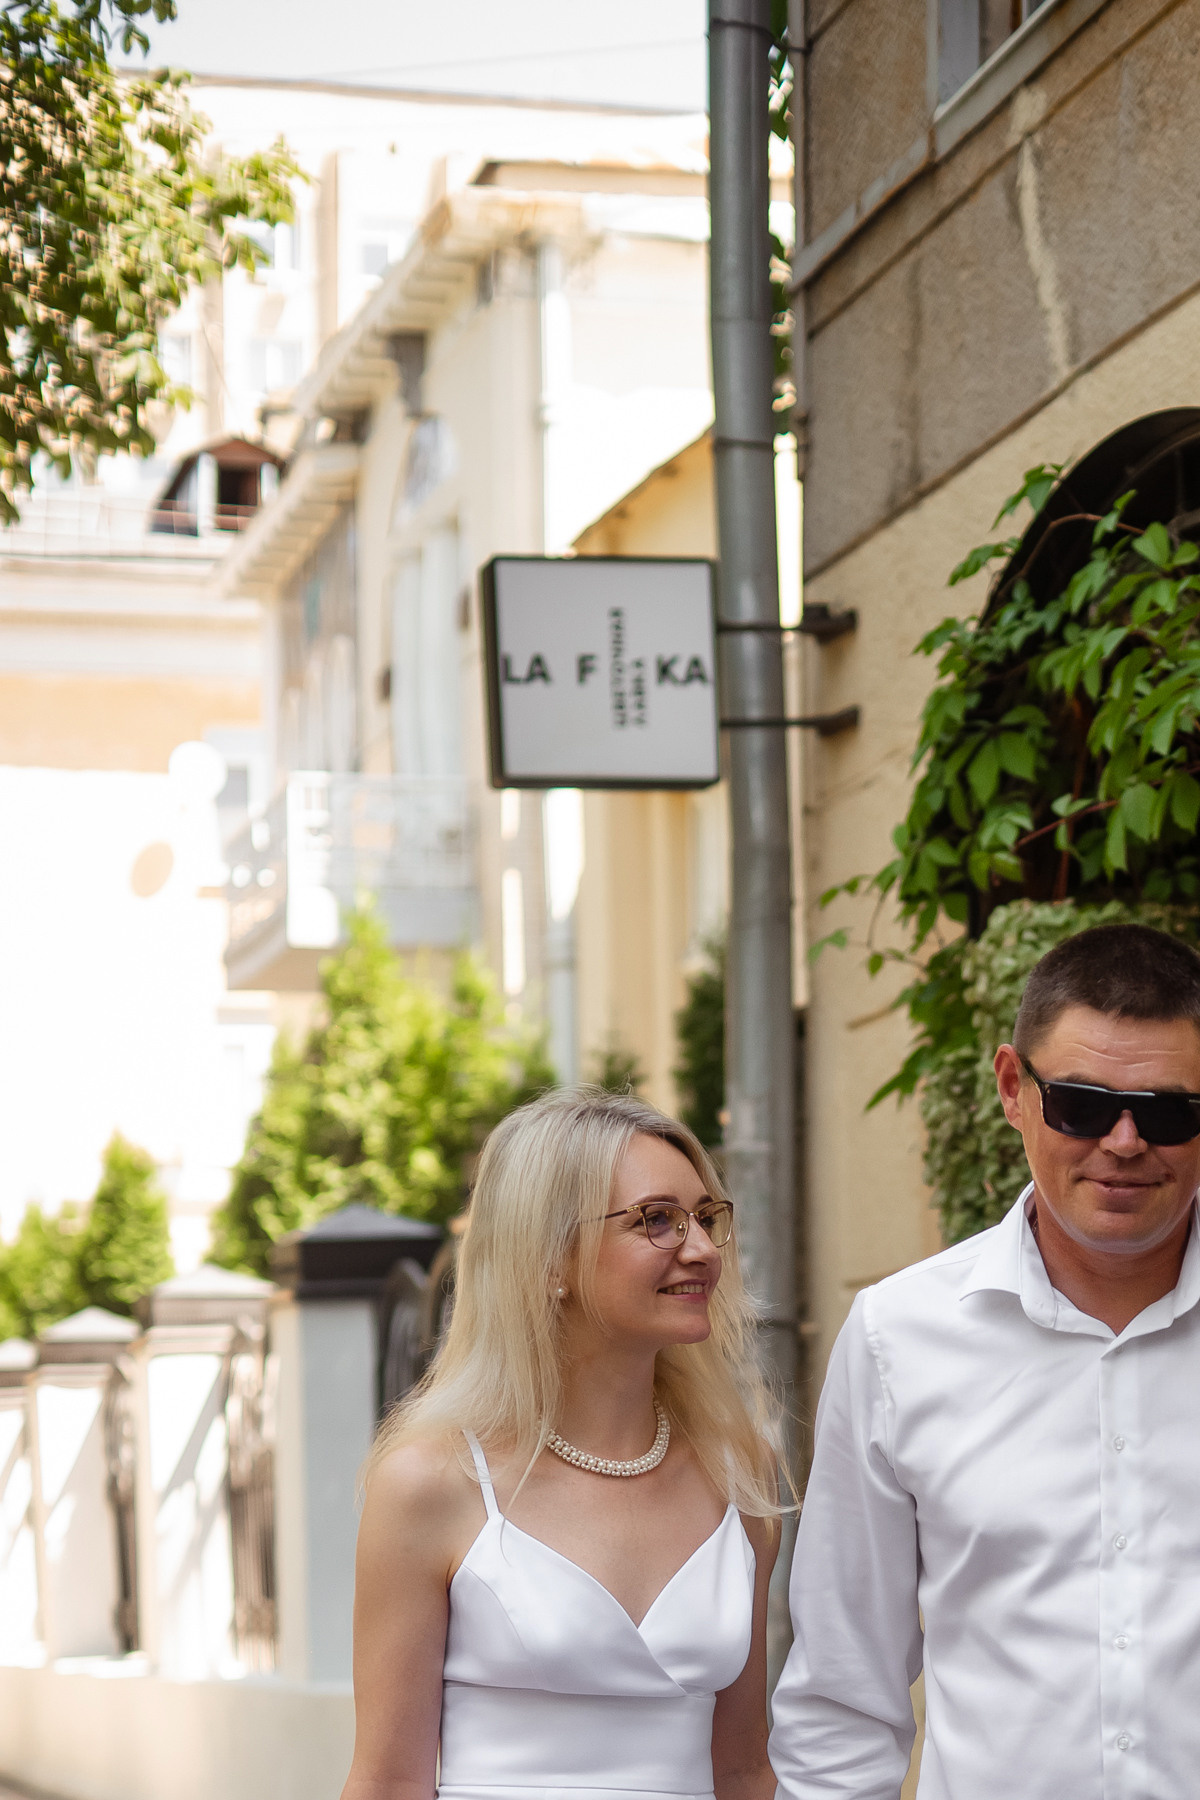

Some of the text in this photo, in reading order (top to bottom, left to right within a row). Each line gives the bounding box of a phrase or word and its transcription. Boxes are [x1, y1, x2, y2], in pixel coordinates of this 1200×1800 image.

[501, 654, 709, 685] LA F KA
